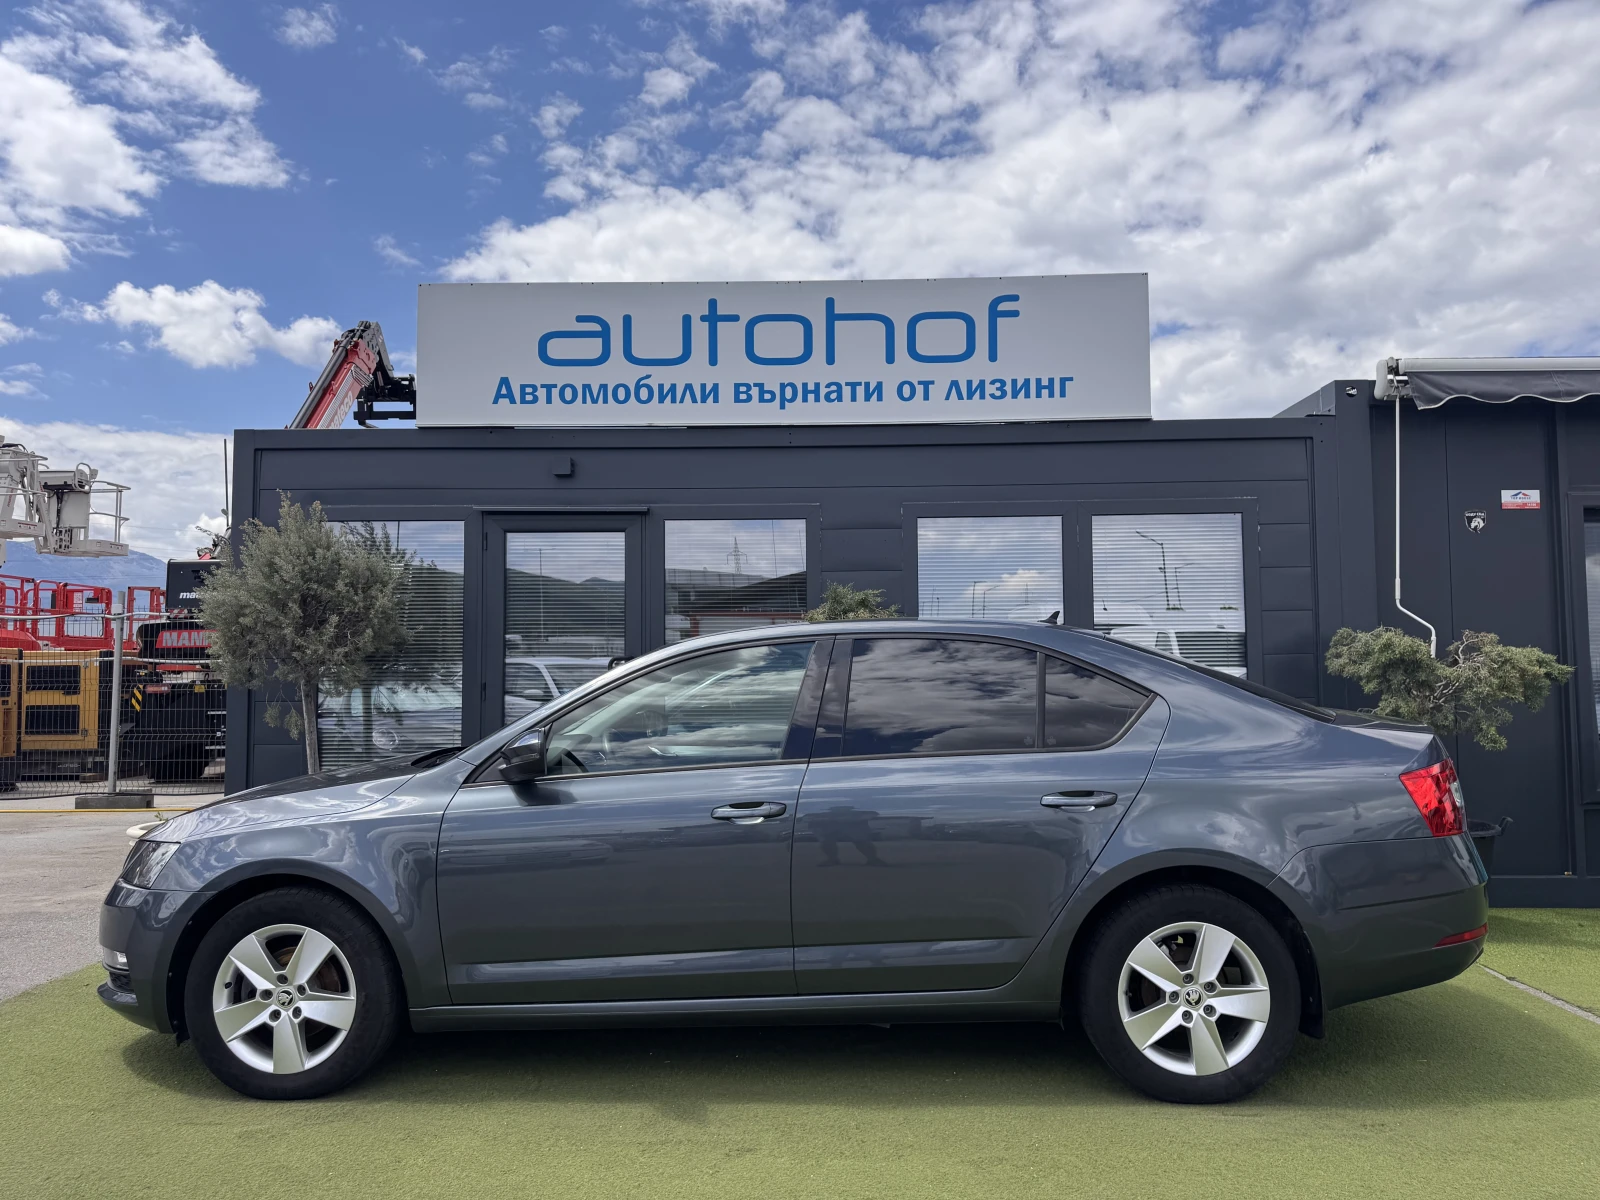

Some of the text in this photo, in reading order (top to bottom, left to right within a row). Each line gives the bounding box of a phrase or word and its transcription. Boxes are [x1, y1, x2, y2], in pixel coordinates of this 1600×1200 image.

[537, 293, 1021, 368] autohof
[492, 374, 1074, 411] Автомобили върнати от лизинг
